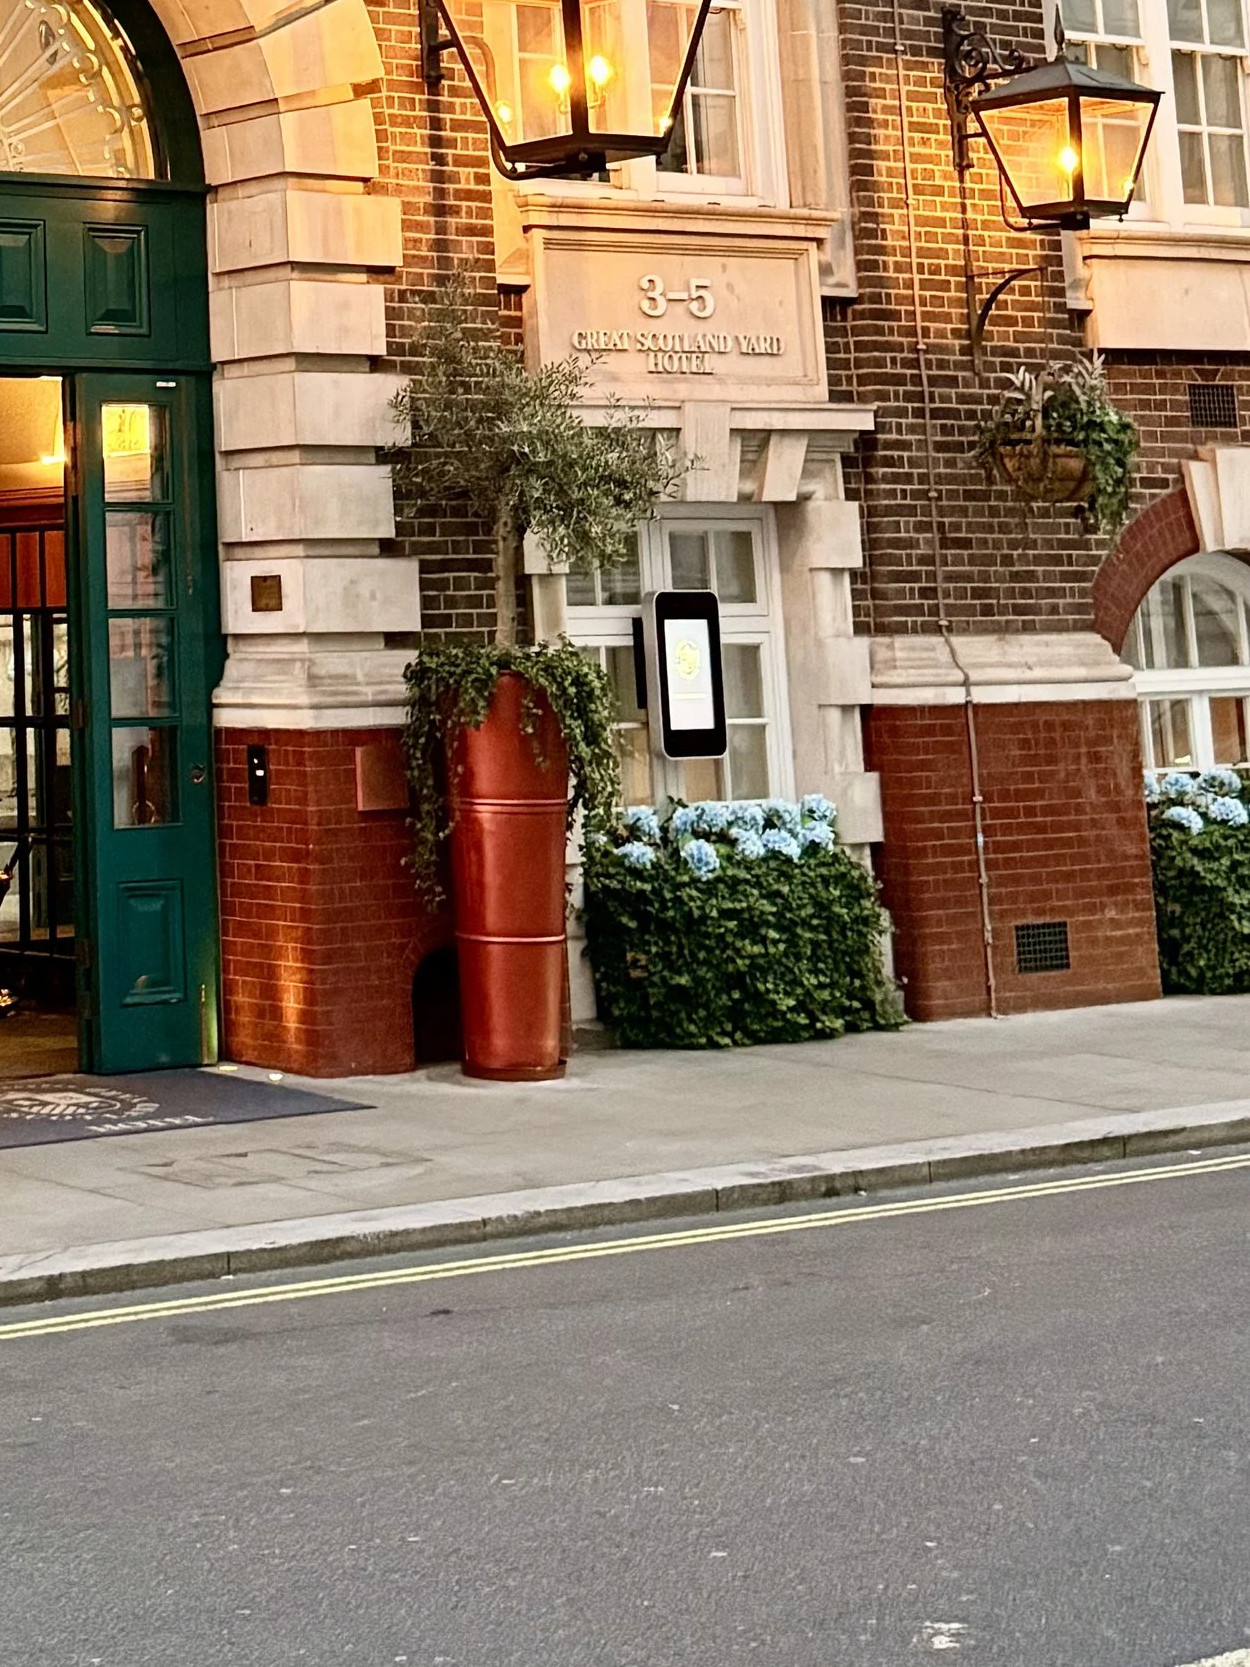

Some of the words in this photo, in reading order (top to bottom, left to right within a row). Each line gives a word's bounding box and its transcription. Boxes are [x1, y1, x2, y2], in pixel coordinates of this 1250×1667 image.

[572, 330, 631, 351] GREAT
[636, 332, 733, 354] SCOTLAND
[738, 334, 786, 356] YARD
[647, 351, 716, 375] HOTEL
